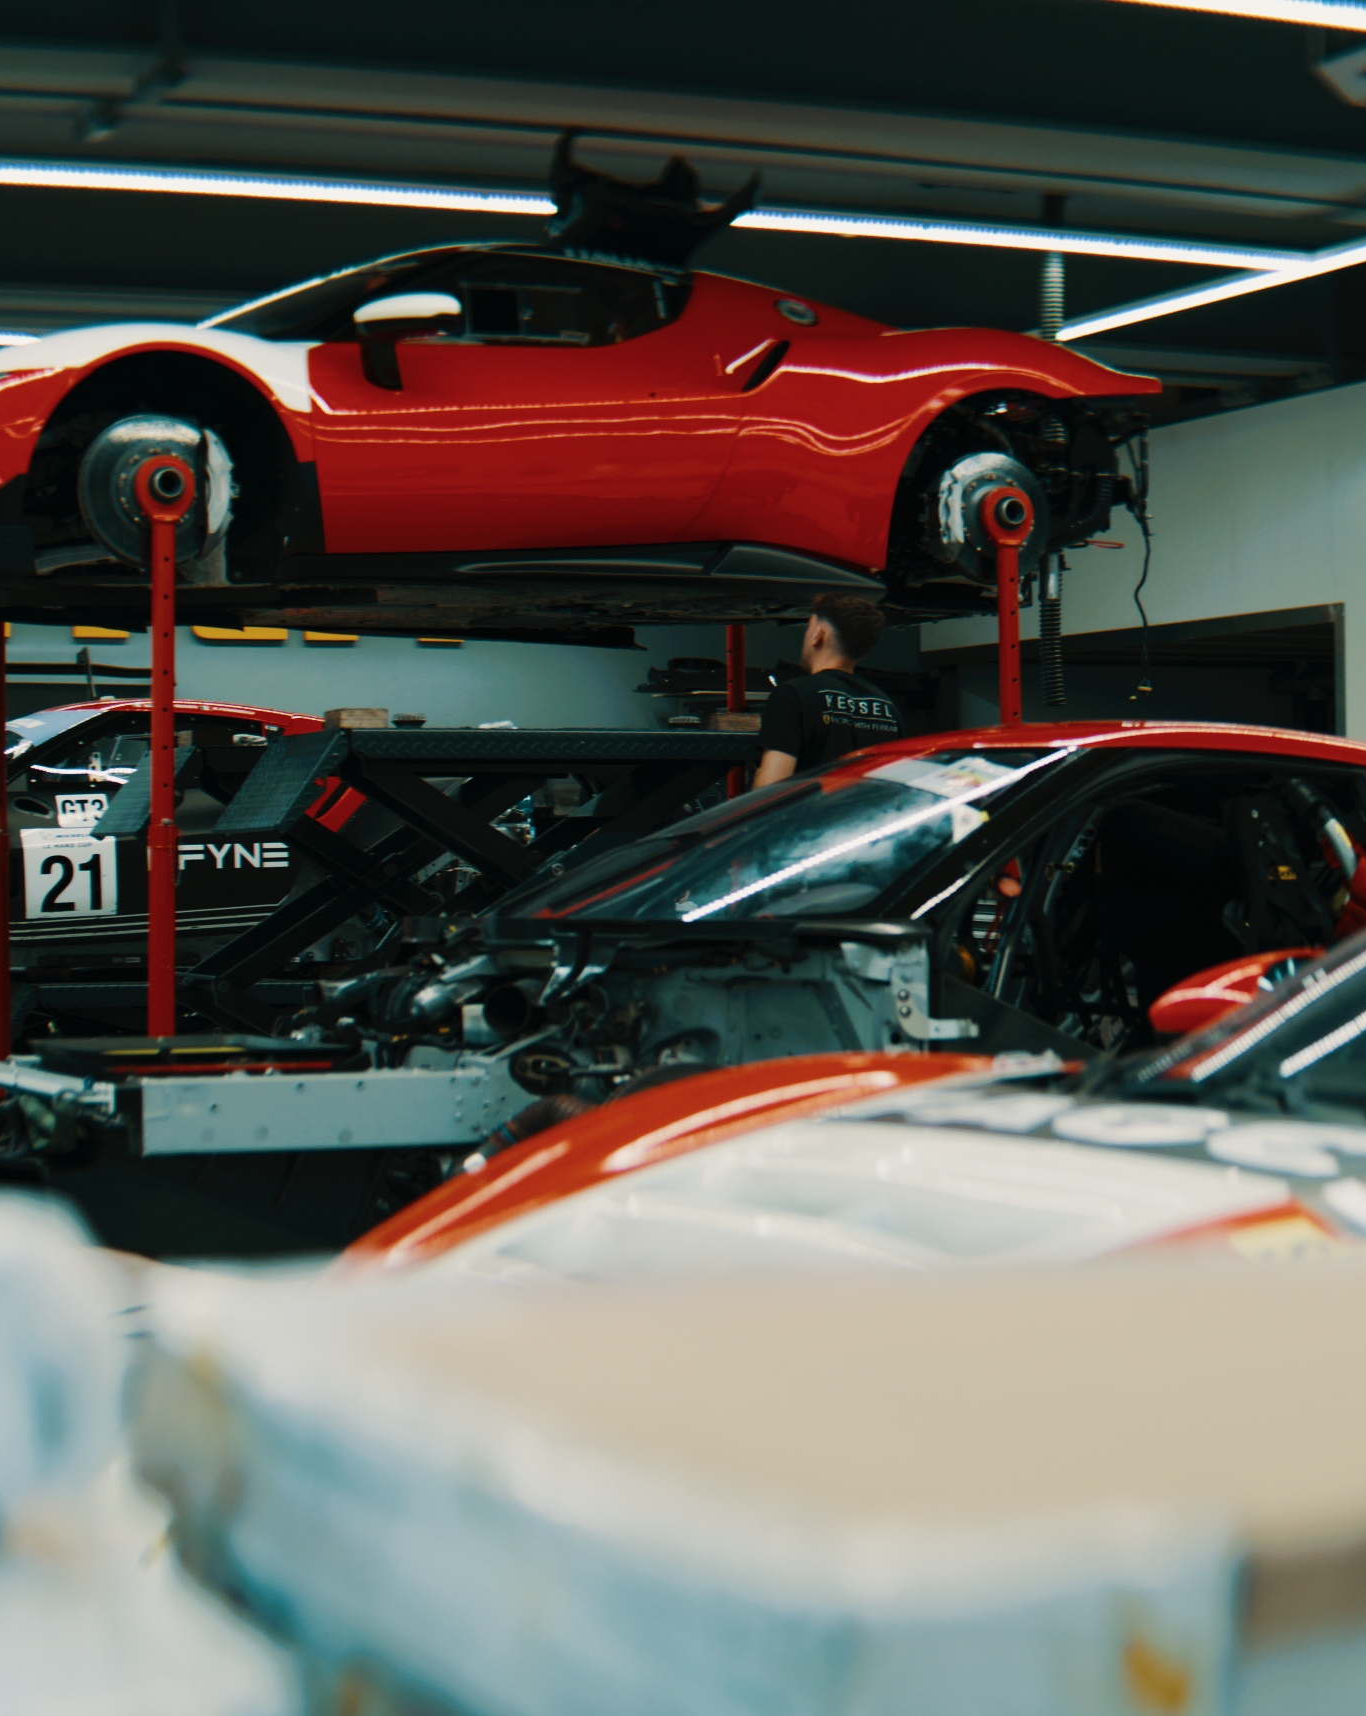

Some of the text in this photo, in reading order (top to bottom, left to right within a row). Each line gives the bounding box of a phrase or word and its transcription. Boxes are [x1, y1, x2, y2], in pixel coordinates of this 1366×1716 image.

[872, 723, 898, 733] FERRAR
[61, 799, 104, 822] GT3
[147, 842, 290, 871] FYNE
[39, 854, 103, 913] 21
